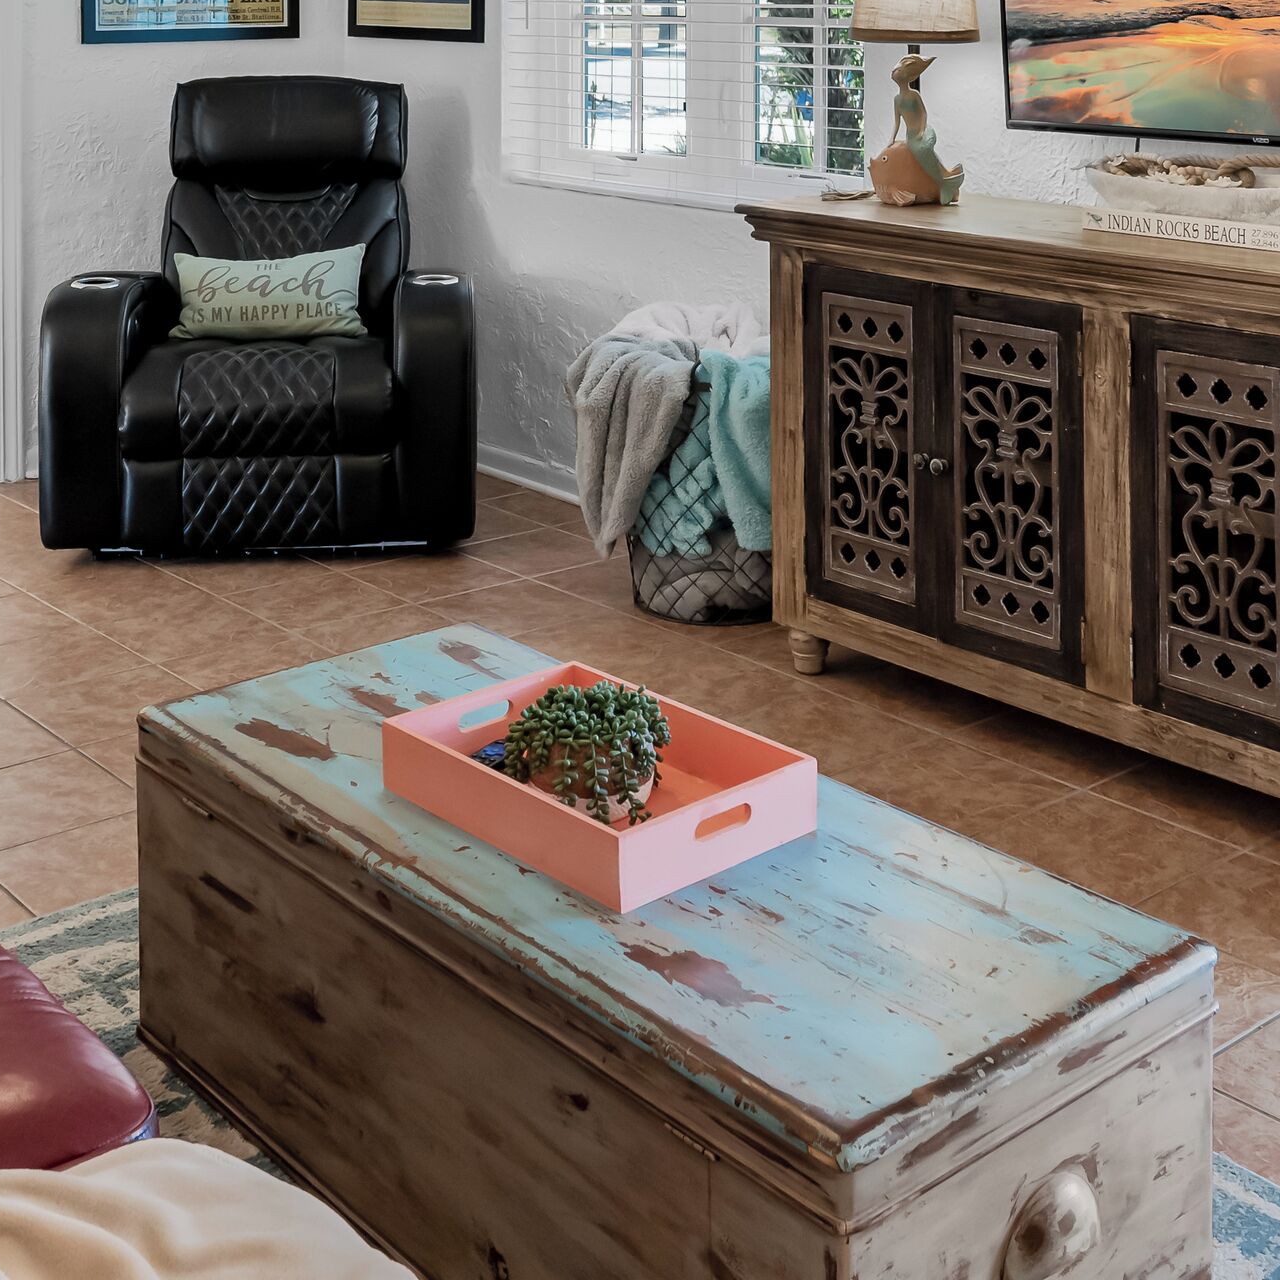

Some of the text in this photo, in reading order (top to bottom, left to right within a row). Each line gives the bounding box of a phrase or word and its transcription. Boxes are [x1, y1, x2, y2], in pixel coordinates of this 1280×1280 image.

[1108, 214, 1247, 245] INDIAN ROCKS BEACH
[255, 263, 282, 272] THE
[183, 260, 357, 304] beach
[192, 301, 343, 325] IS MY HAPPY PLACE
